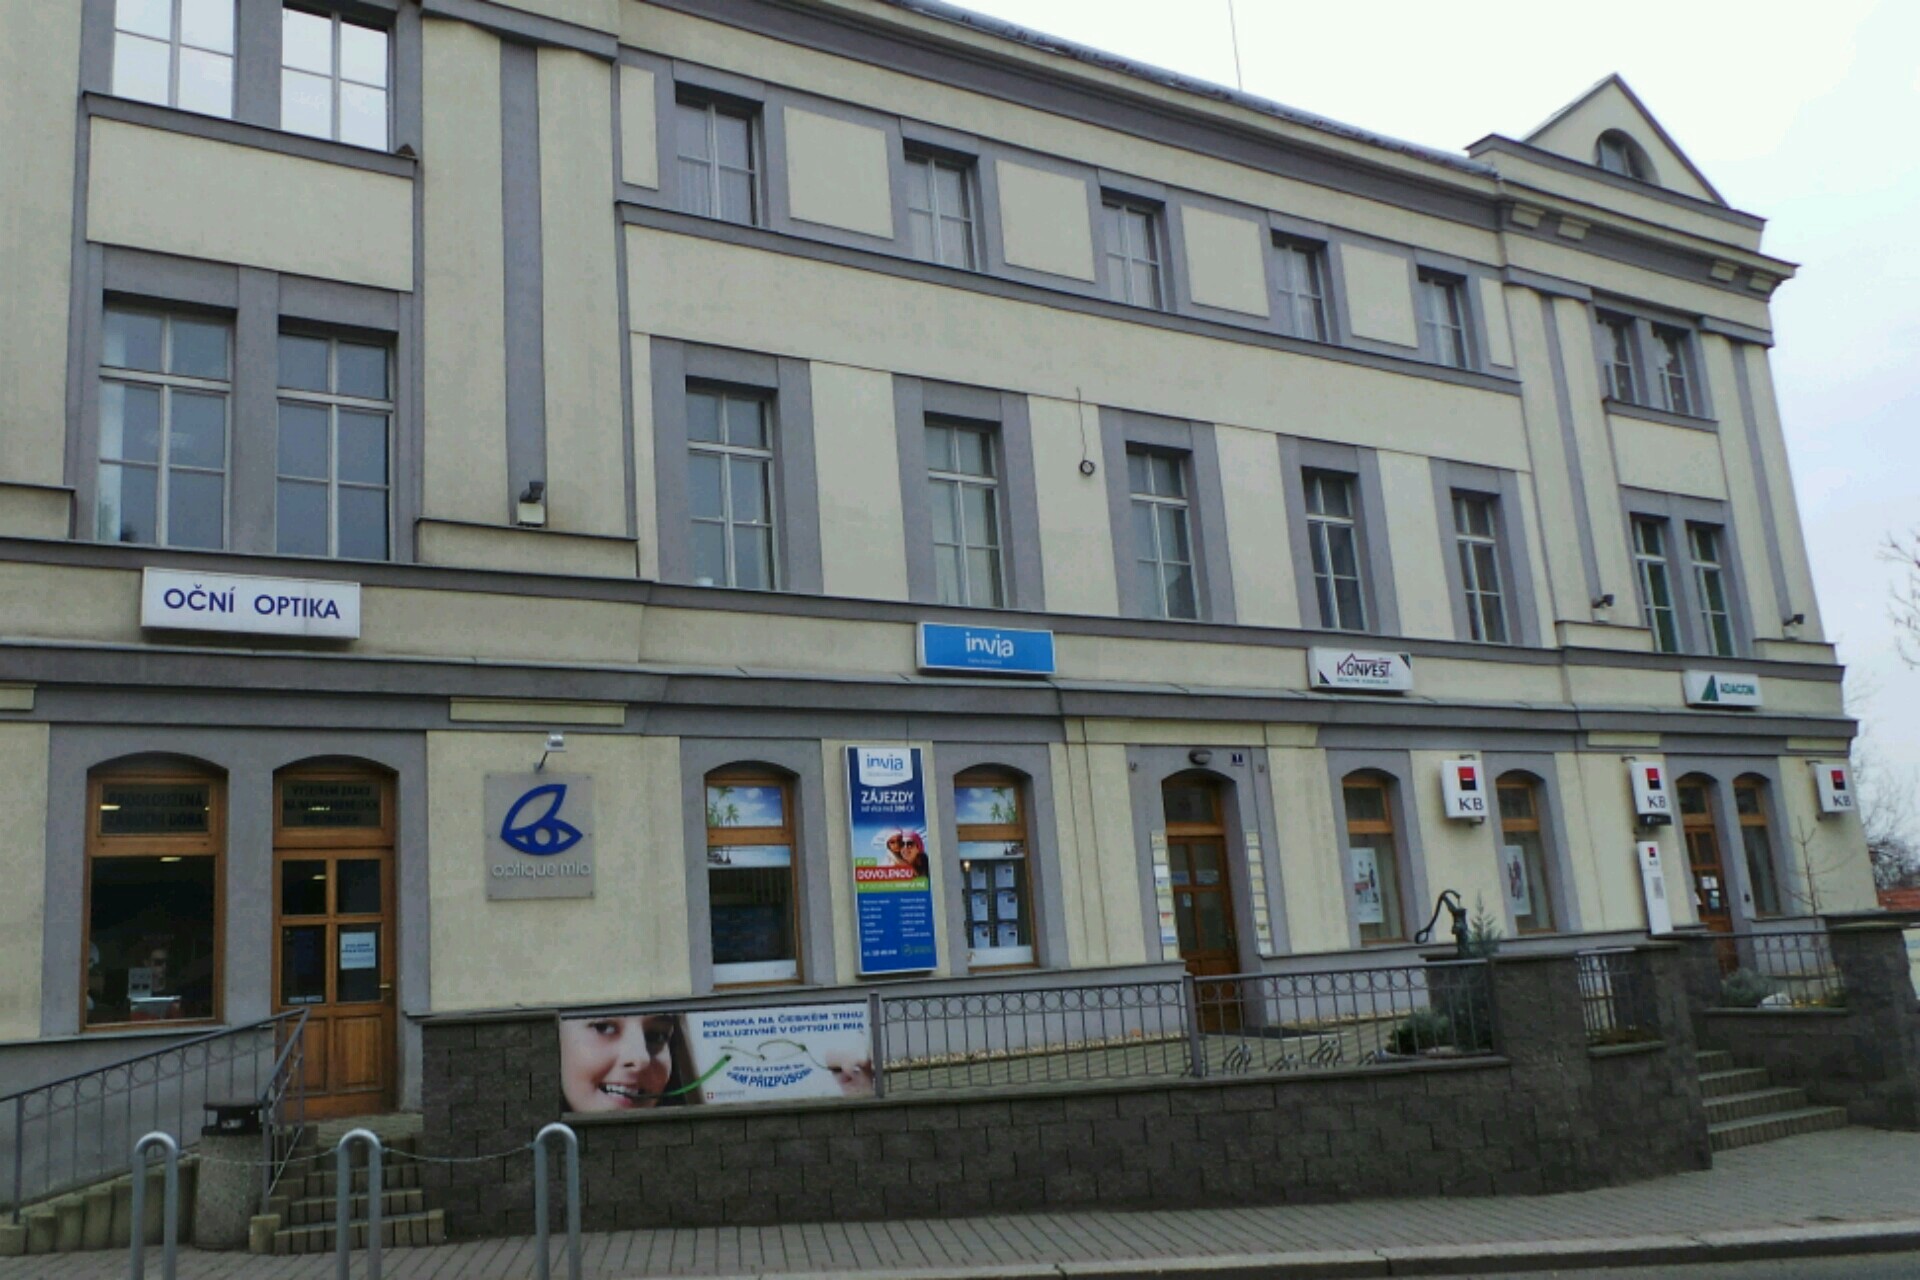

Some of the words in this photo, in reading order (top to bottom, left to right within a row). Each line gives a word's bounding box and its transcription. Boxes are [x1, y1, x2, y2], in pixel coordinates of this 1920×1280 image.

[164, 584, 236, 613] OČNÍ
[254, 594, 340, 619] OPTIKA
[965, 631, 1014, 658] invia
[1336, 652, 1391, 677] KONVEST
[866, 753, 903, 770] invia
[861, 788, 914, 804] ZÁJEZDY
[1458, 797, 1484, 811] KB
[1647, 795, 1666, 809] KB
[1832, 795, 1851, 807] KB
[857, 868, 913, 880] DOVOLENOU
[702, 1018, 755, 1028] NOVINKA
[758, 1016, 775, 1024] NA
[778, 1012, 828, 1023] ČESKÉM
[832, 1011, 864, 1020] TRHU
[703, 1027, 777, 1038] EXKLUZIVNĚ
[780, 1026, 787, 1034] V
[789, 1023, 840, 1033] OPTIQUE
[843, 1022, 864, 1030] MIA
